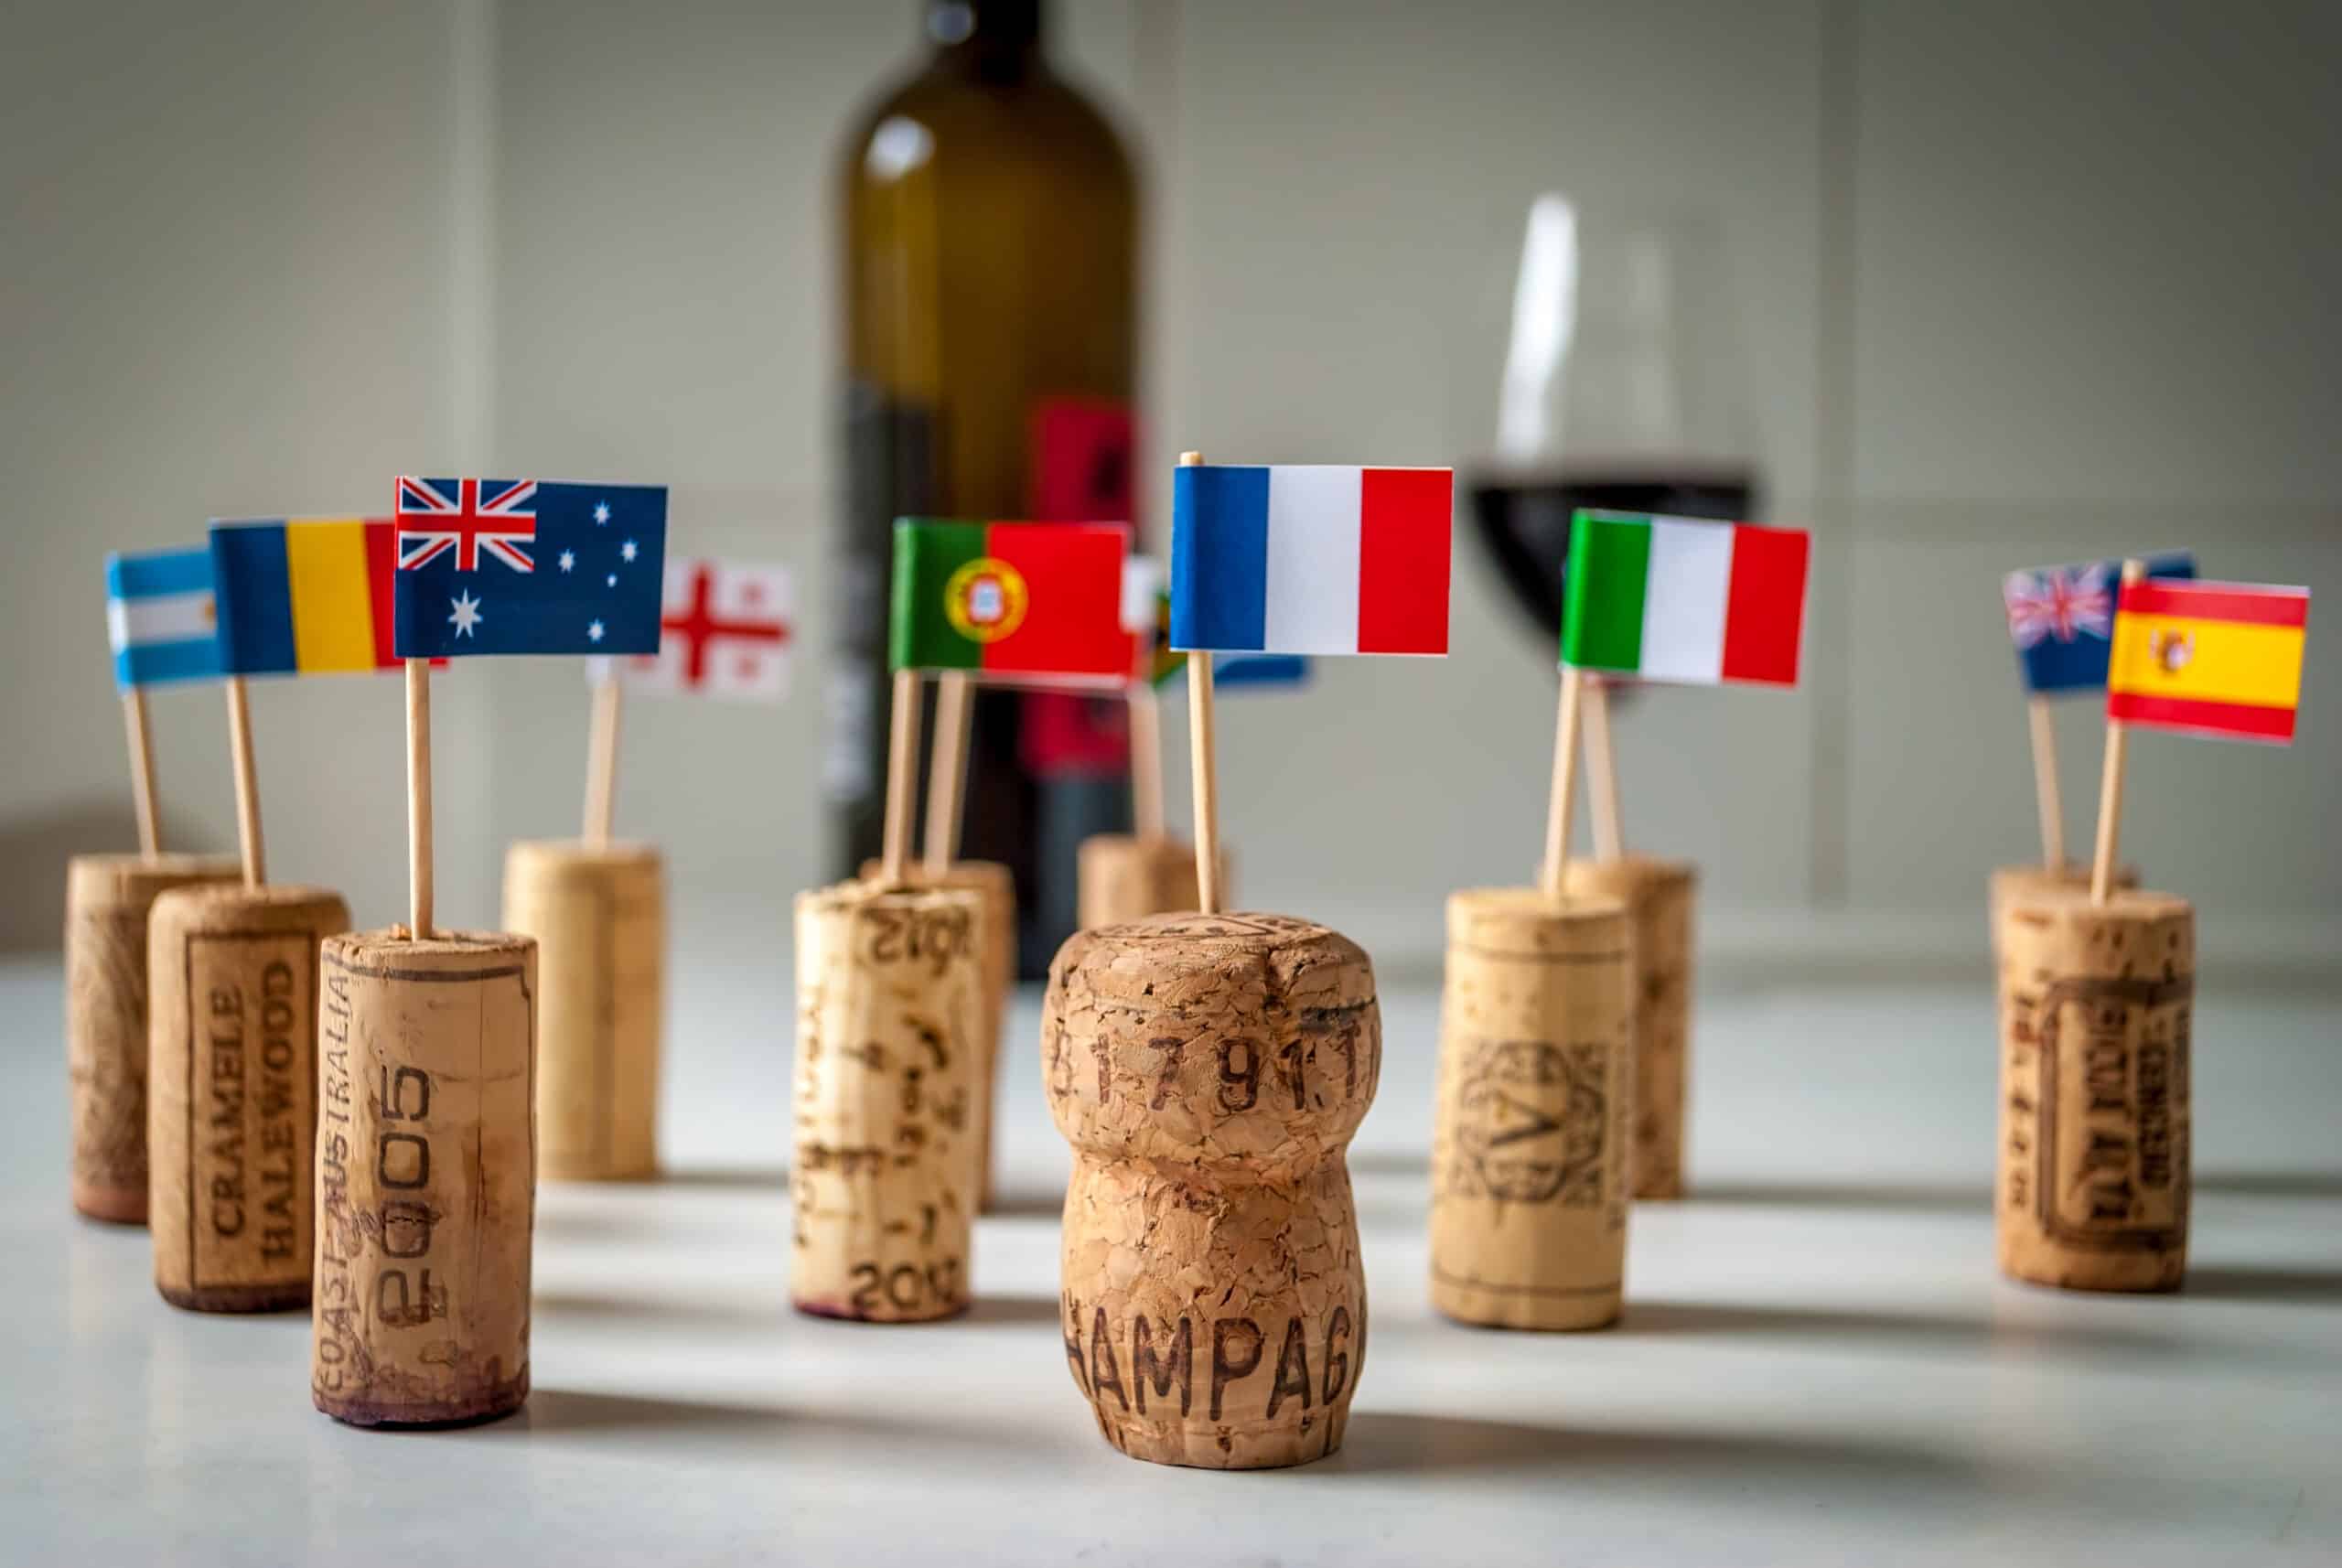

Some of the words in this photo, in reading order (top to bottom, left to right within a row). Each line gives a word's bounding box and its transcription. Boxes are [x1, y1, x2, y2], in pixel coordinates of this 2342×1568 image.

[211, 984, 245, 1238] CRAMELE
[262, 961, 295, 1262] HALEWOOD
[323, 975, 349, 1224] AUSTRALIA
[377, 1065, 431, 1326] 2005
